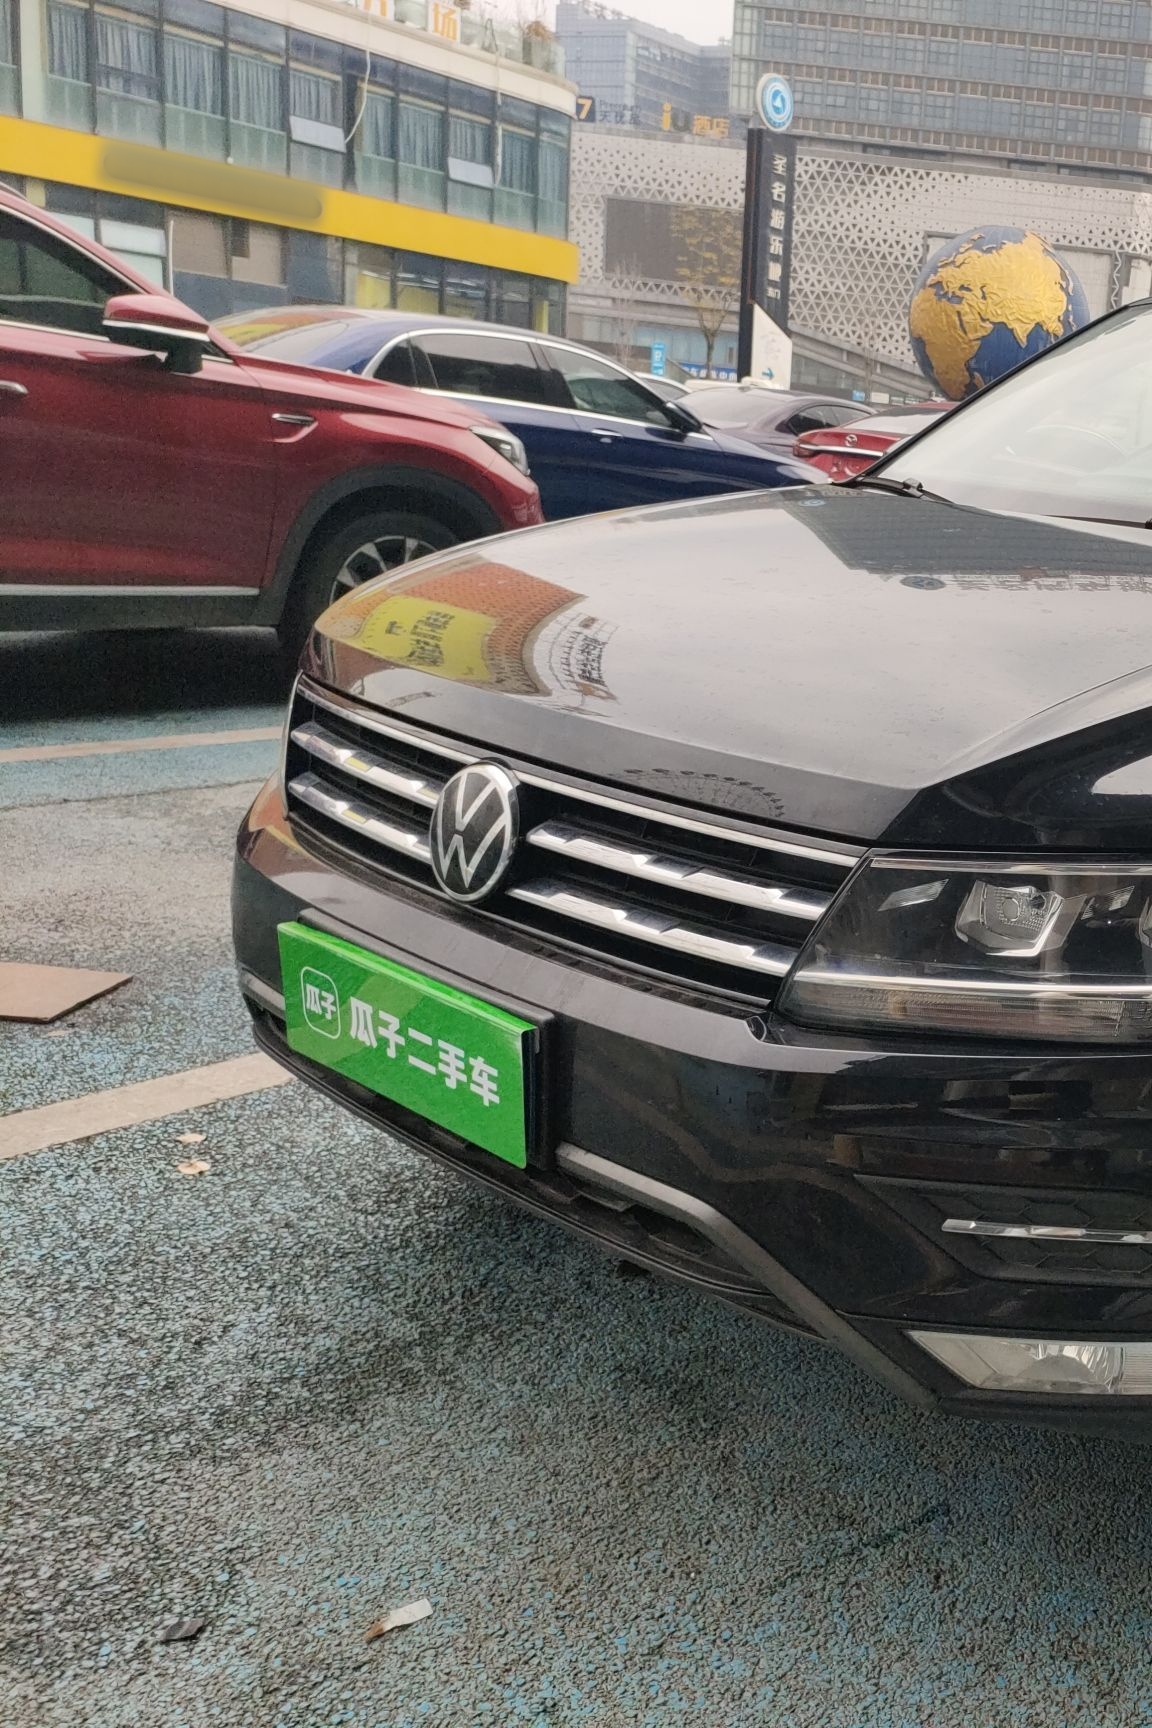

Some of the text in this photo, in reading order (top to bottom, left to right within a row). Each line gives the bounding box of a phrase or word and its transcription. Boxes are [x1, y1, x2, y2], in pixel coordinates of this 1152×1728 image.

[305, 983, 338, 1022] 瓜子
[349, 995, 501, 1108] 瓜子二手车
